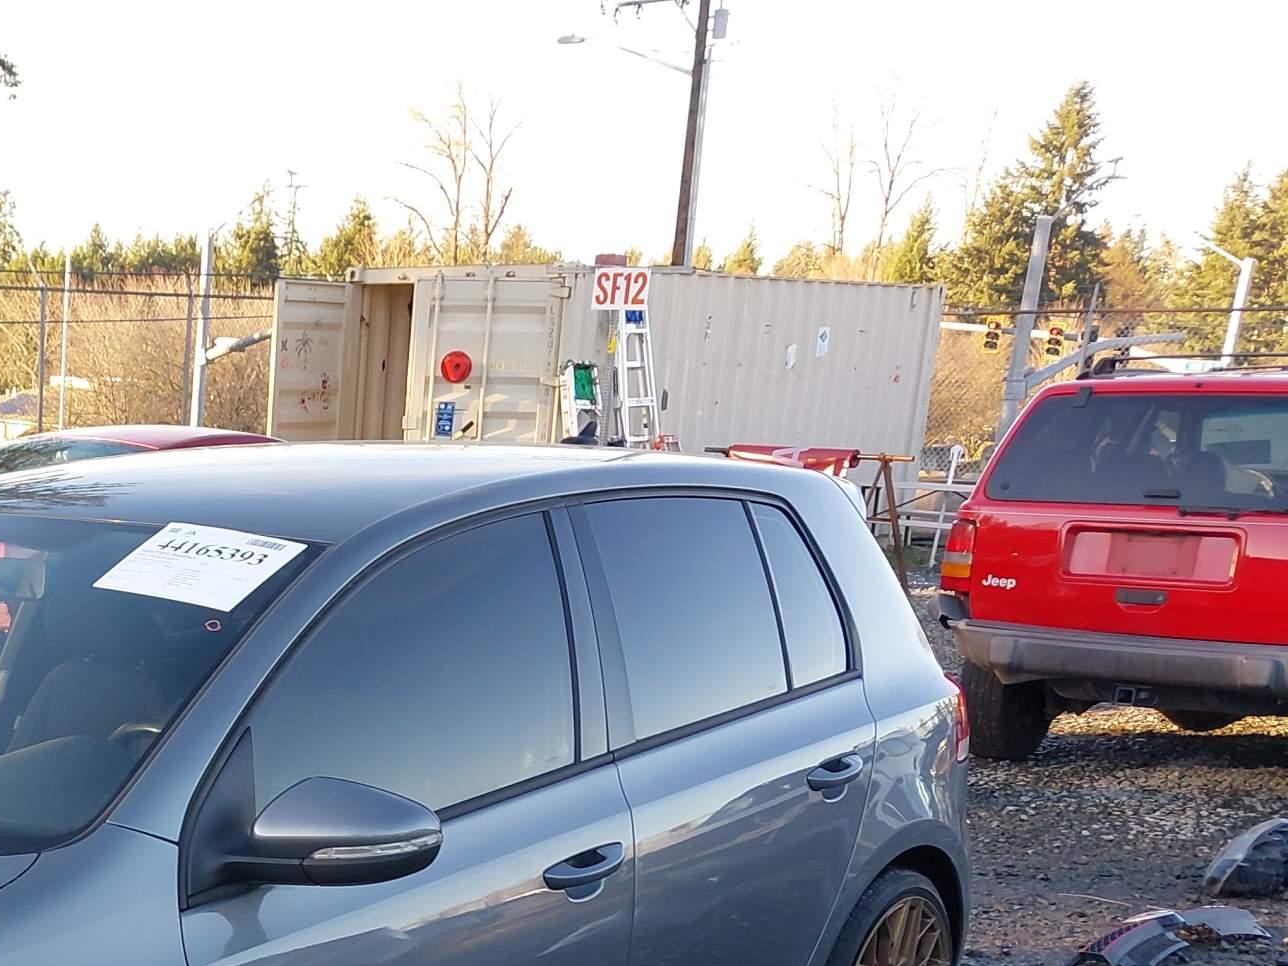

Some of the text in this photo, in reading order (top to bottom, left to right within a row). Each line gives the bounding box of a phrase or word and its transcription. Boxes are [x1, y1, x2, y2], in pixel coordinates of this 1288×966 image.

[595, 271, 648, 305] SF12
[157, 539, 268, 566] 44165393
[982, 574, 1016, 590] Jeep
